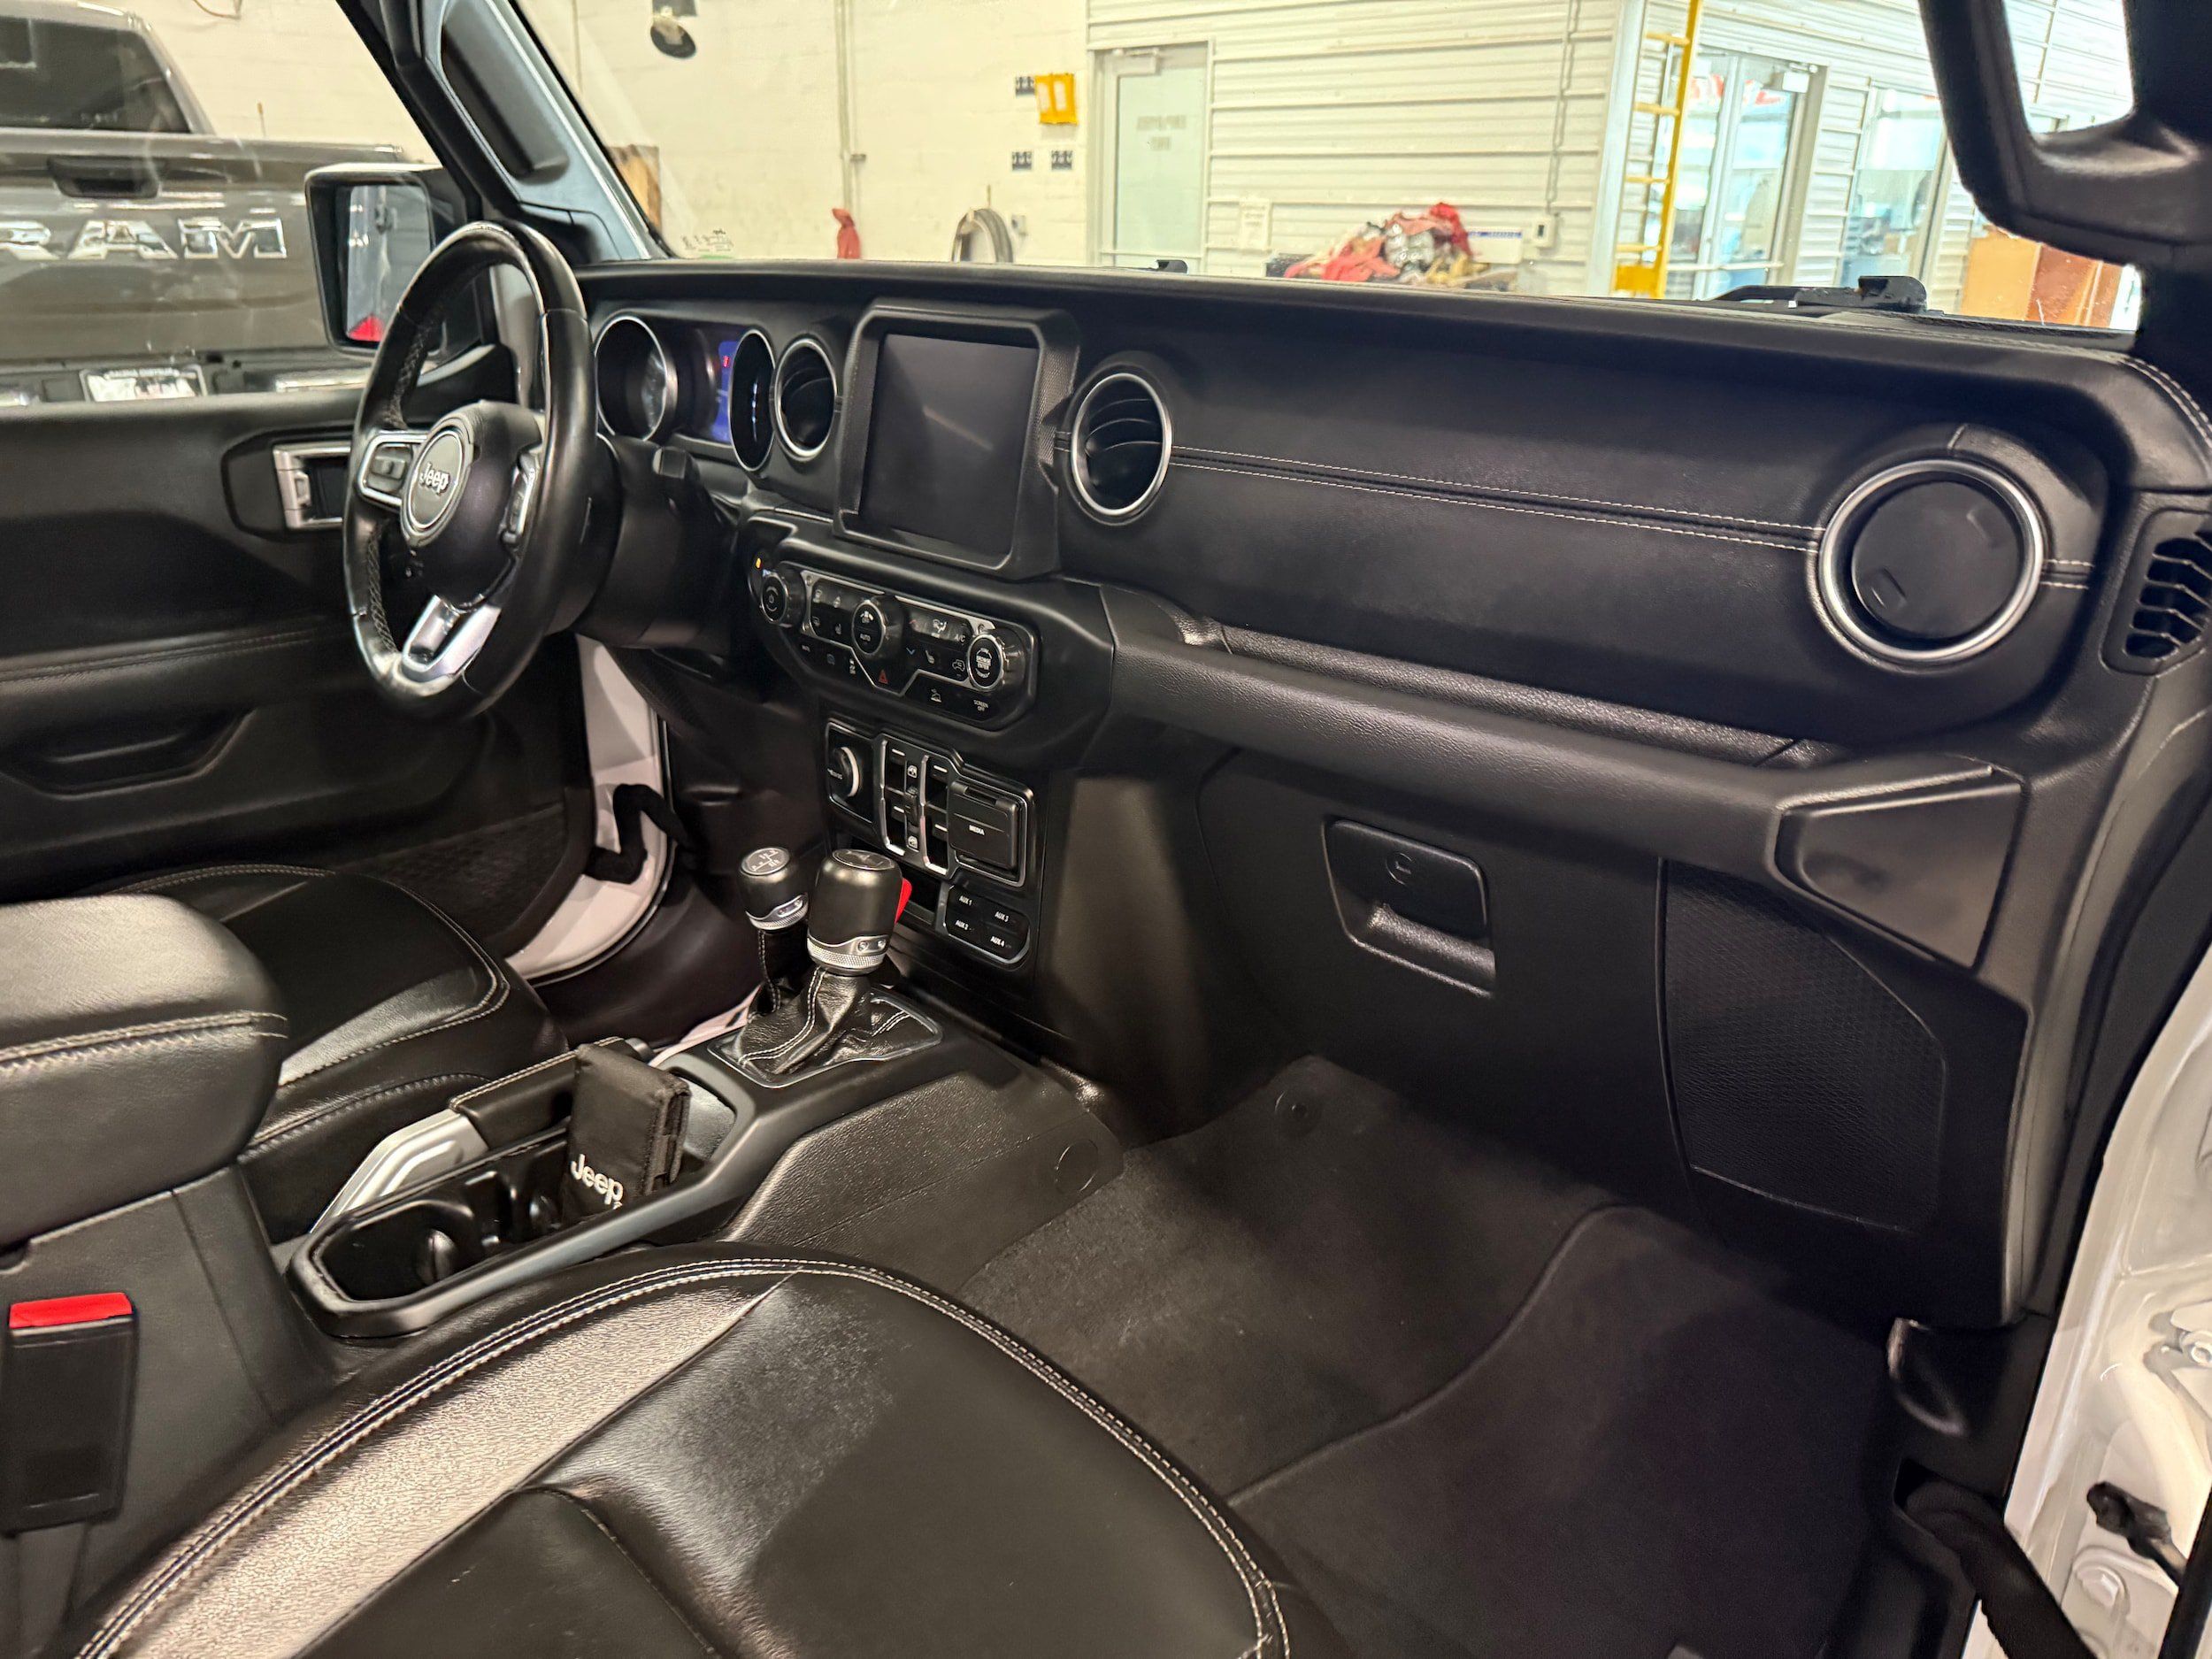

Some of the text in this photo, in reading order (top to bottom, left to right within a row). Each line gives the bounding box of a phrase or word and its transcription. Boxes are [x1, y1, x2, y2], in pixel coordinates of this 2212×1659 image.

[0, 218, 287, 259] RAM
[419, 462, 449, 495] Jeep
[860, 633, 871, 641] AUTO
[969, 825, 985, 836] MEDIA
[959, 895, 969, 905] AUX
[995, 911, 1005, 921] AUX
[955, 919, 964, 929] AUX
[990, 936, 1001, 946] AUX
[570, 1153, 624, 1205] Jeep
